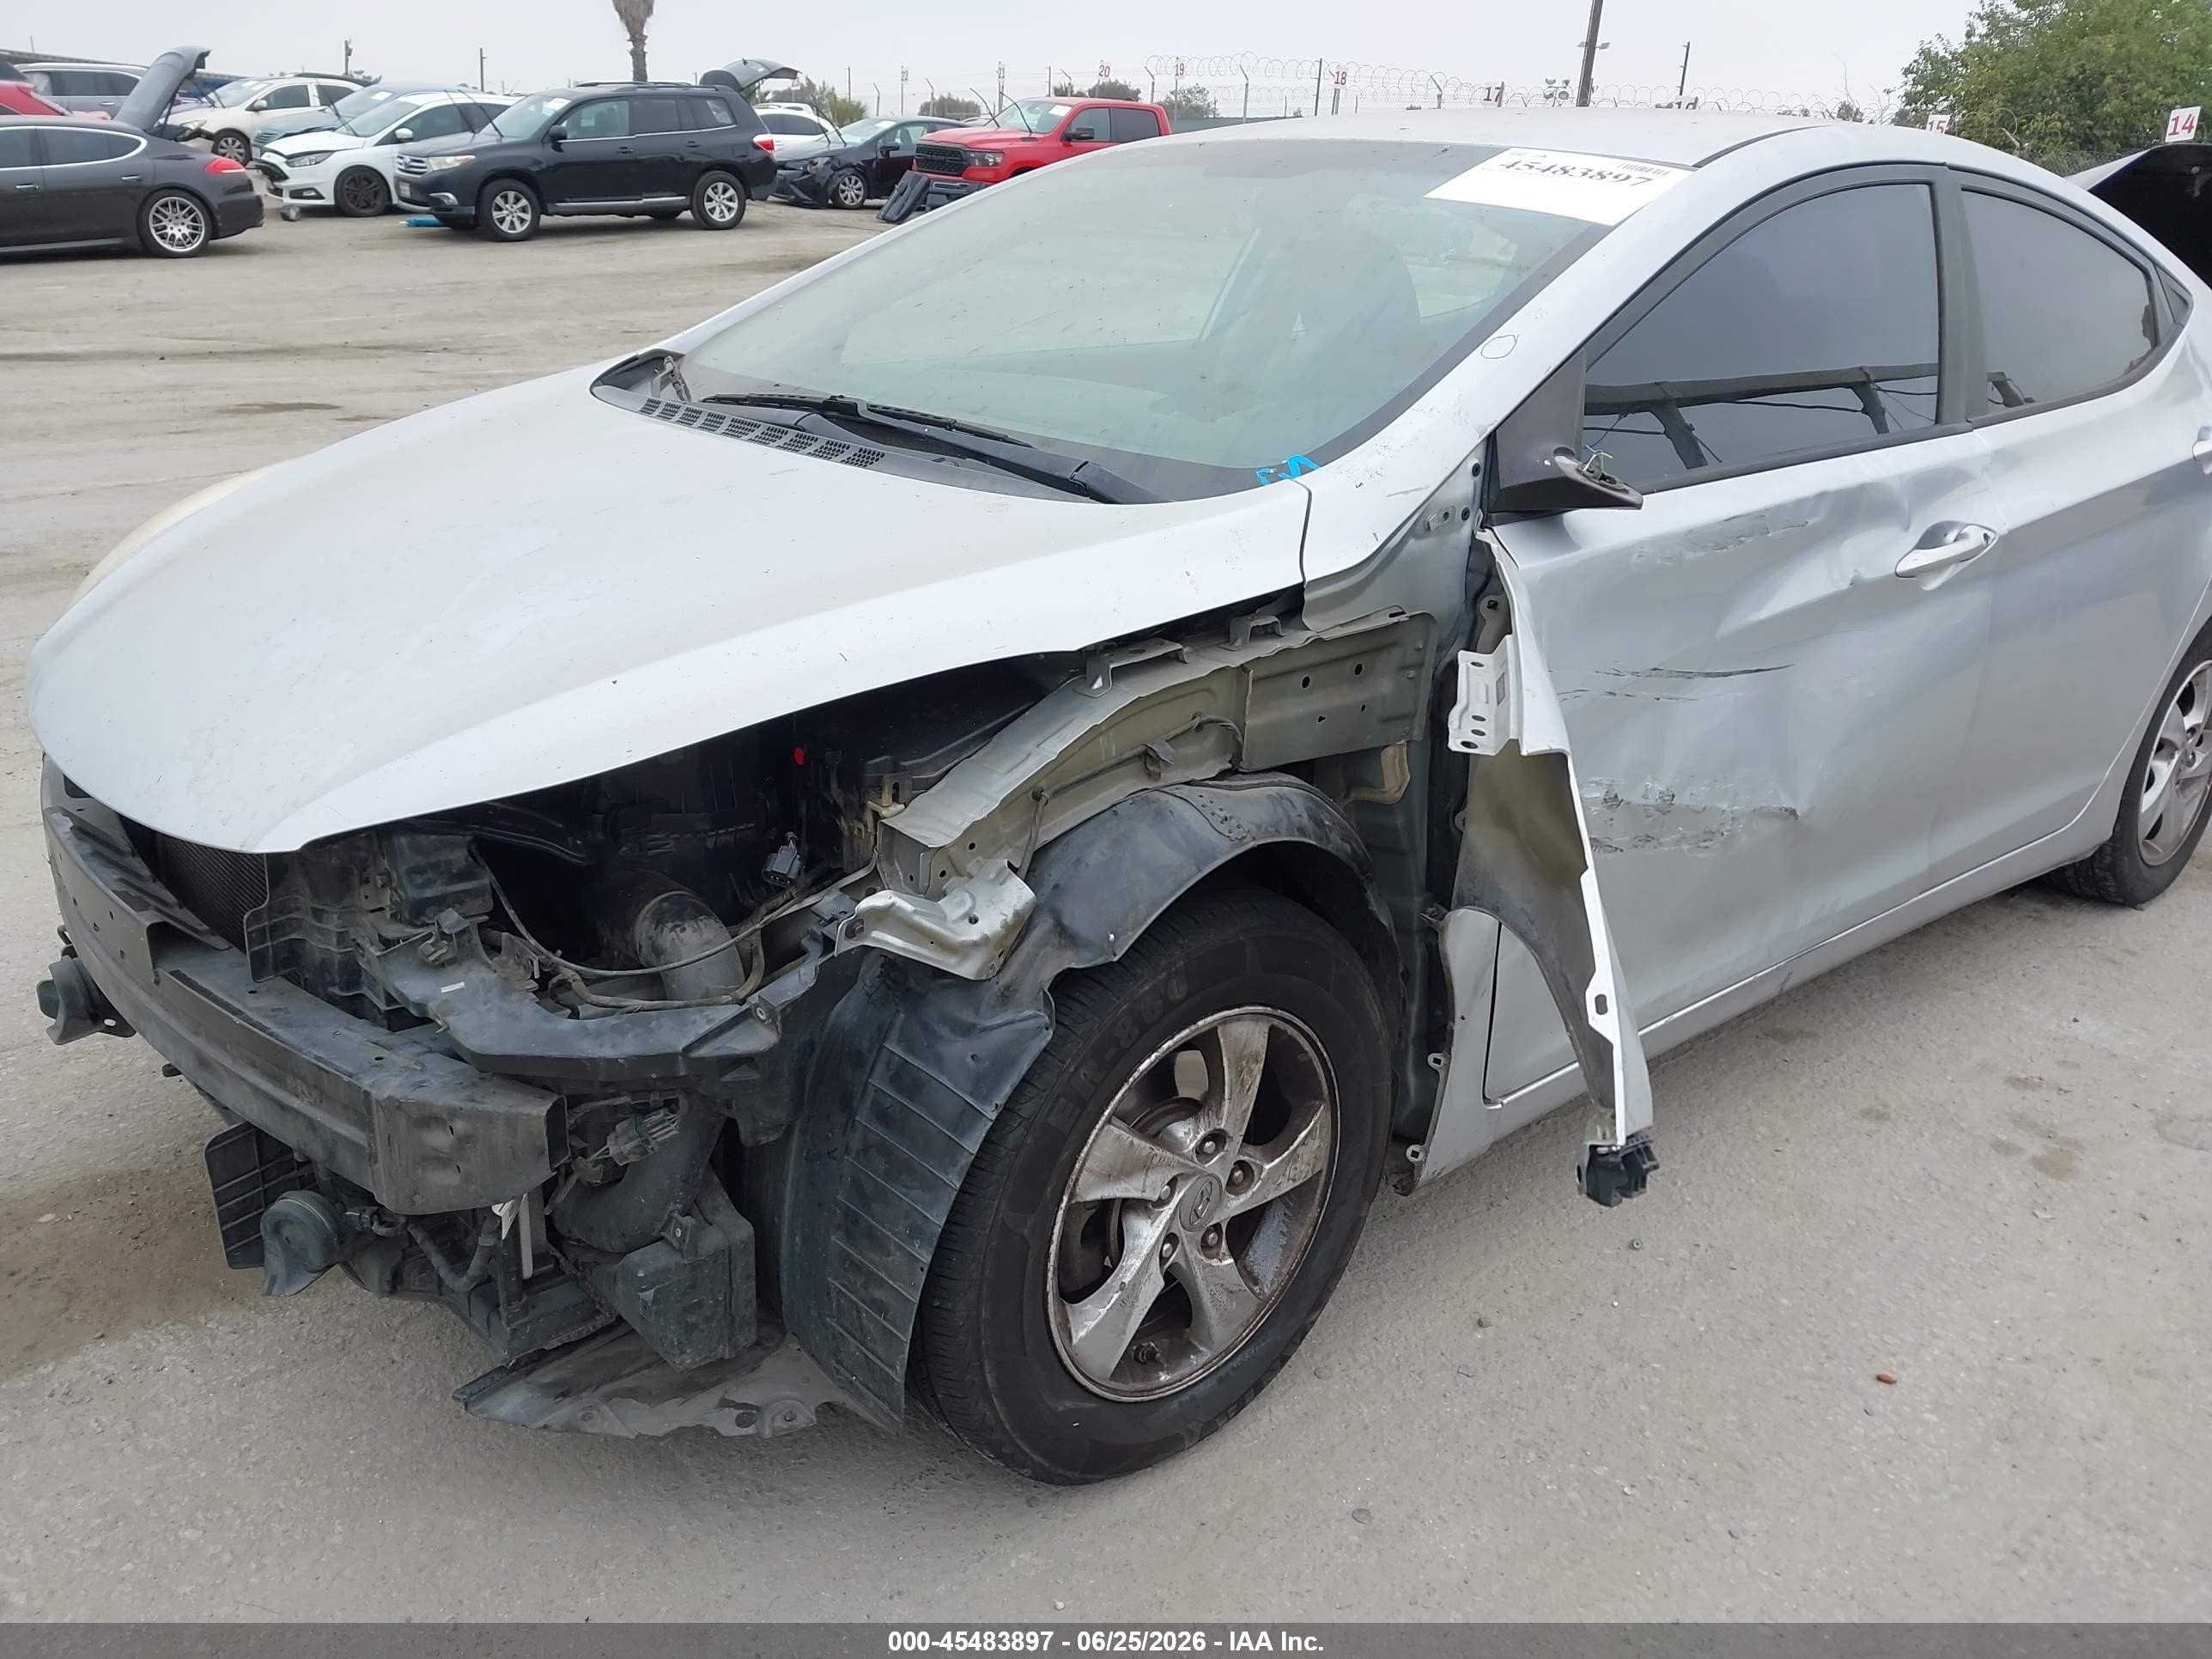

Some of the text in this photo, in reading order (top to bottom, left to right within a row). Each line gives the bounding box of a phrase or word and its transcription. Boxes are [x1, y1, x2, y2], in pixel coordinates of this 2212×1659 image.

[901, 70, 908, 82] 22
[1098, 64, 1110, 77] 20
[1175, 63, 1185, 76] 19
[1334, 70, 1346, 86] 18
[1483, 87, 1502, 102] 17
[1928, 119, 1948, 135] 15
[2168, 113, 2196, 136] 14
[1498, 159, 1656, 187] 45483897
